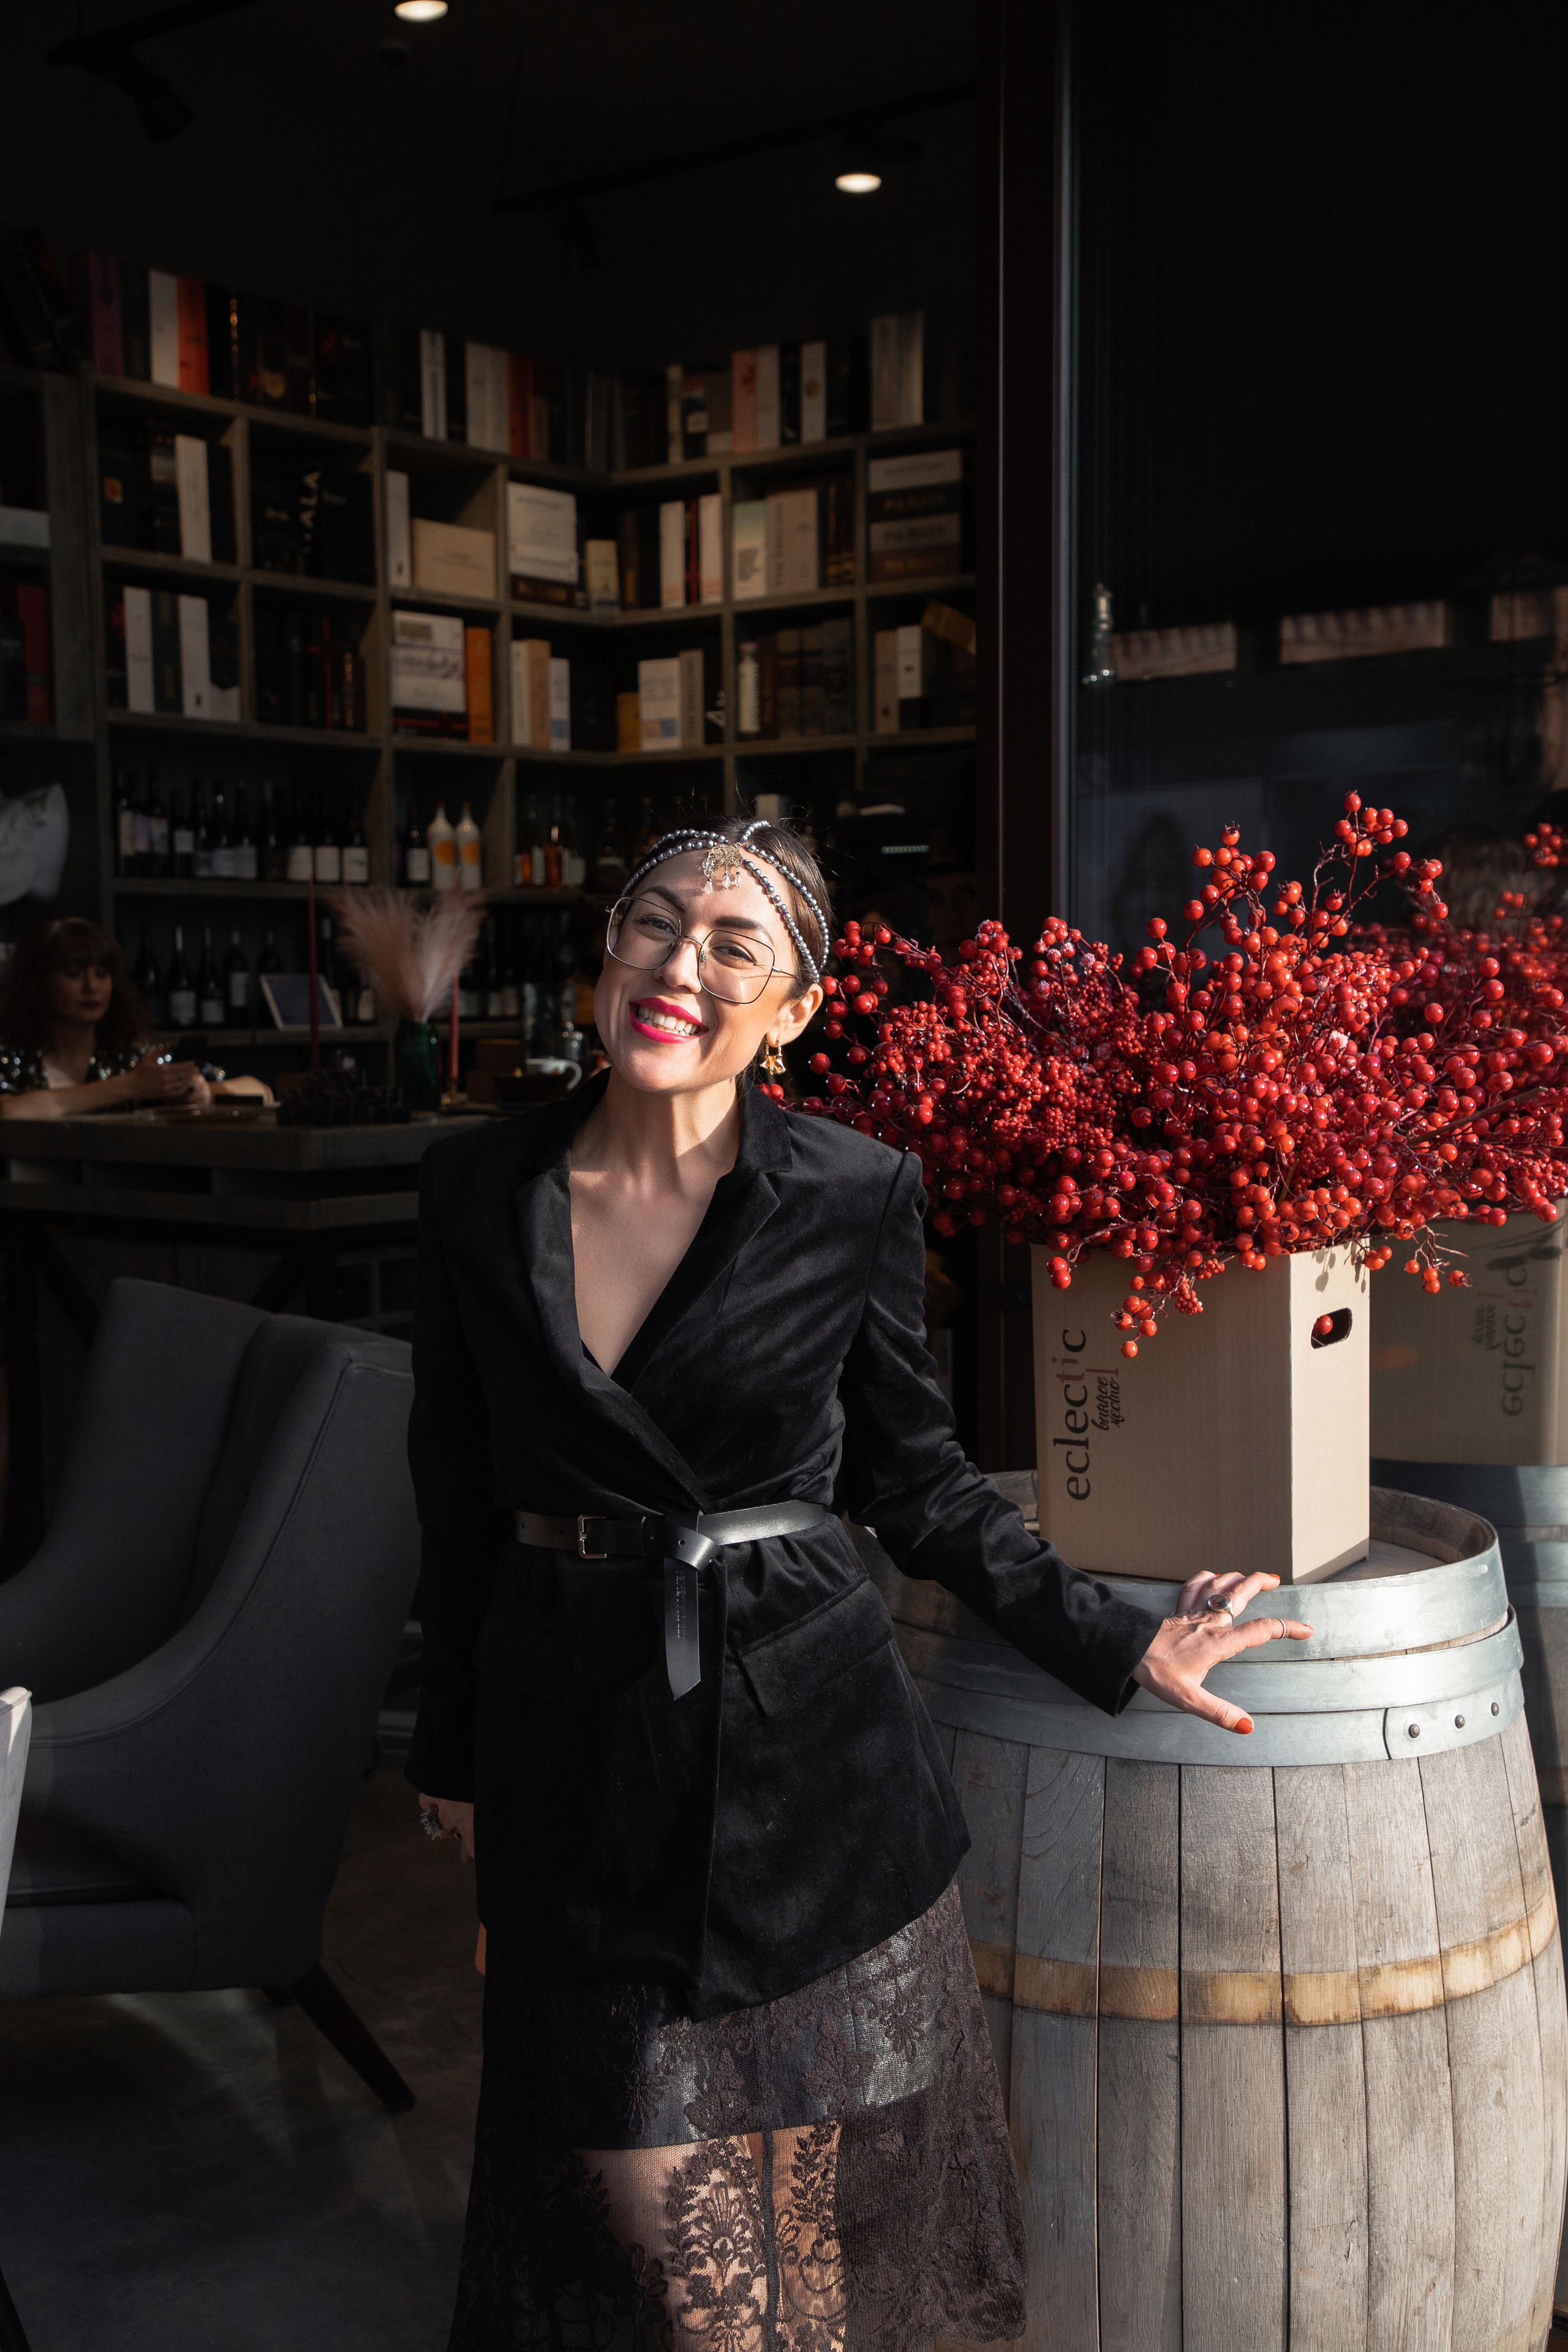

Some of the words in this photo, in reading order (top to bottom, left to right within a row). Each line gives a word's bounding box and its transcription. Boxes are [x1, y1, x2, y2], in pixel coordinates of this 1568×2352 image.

[1050, 1329, 1091, 1501] eclectic
[1091, 1376, 1110, 1431] винное
[1108, 1376, 1126, 1428] место
